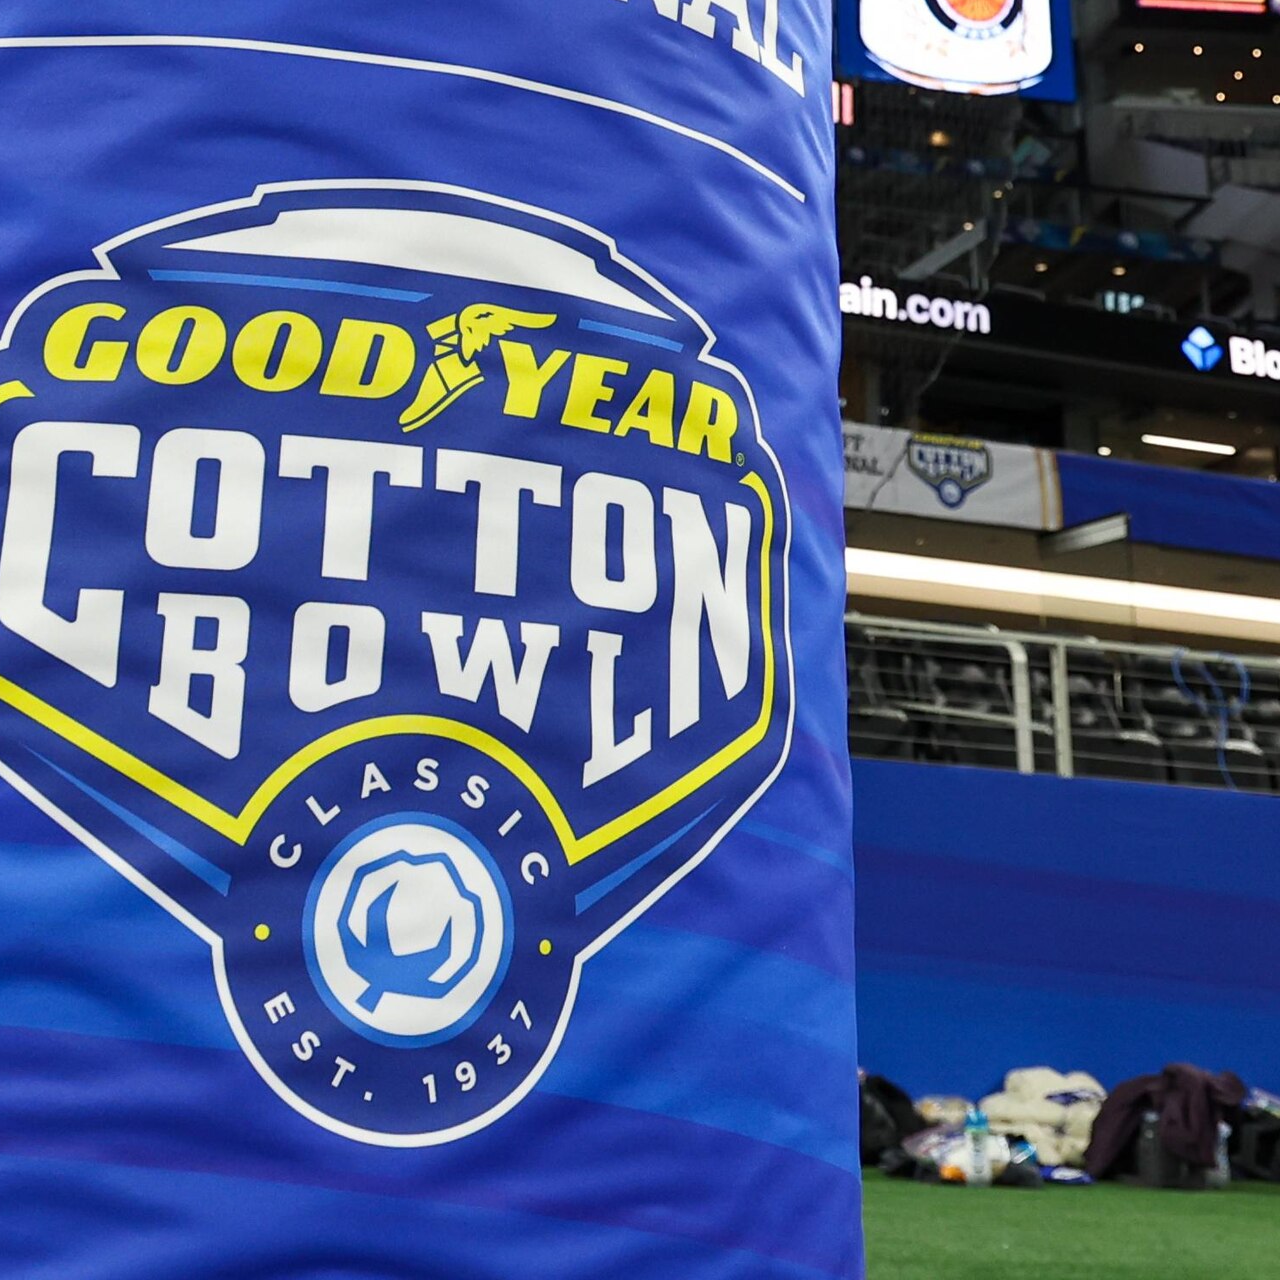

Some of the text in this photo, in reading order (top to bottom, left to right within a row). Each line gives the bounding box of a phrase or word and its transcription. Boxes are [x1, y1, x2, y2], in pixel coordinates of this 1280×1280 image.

[148, 592, 652, 788] BOWL
[269, 758, 550, 885] CLASSIC
[263, 991, 535, 1104] EST. 1937
